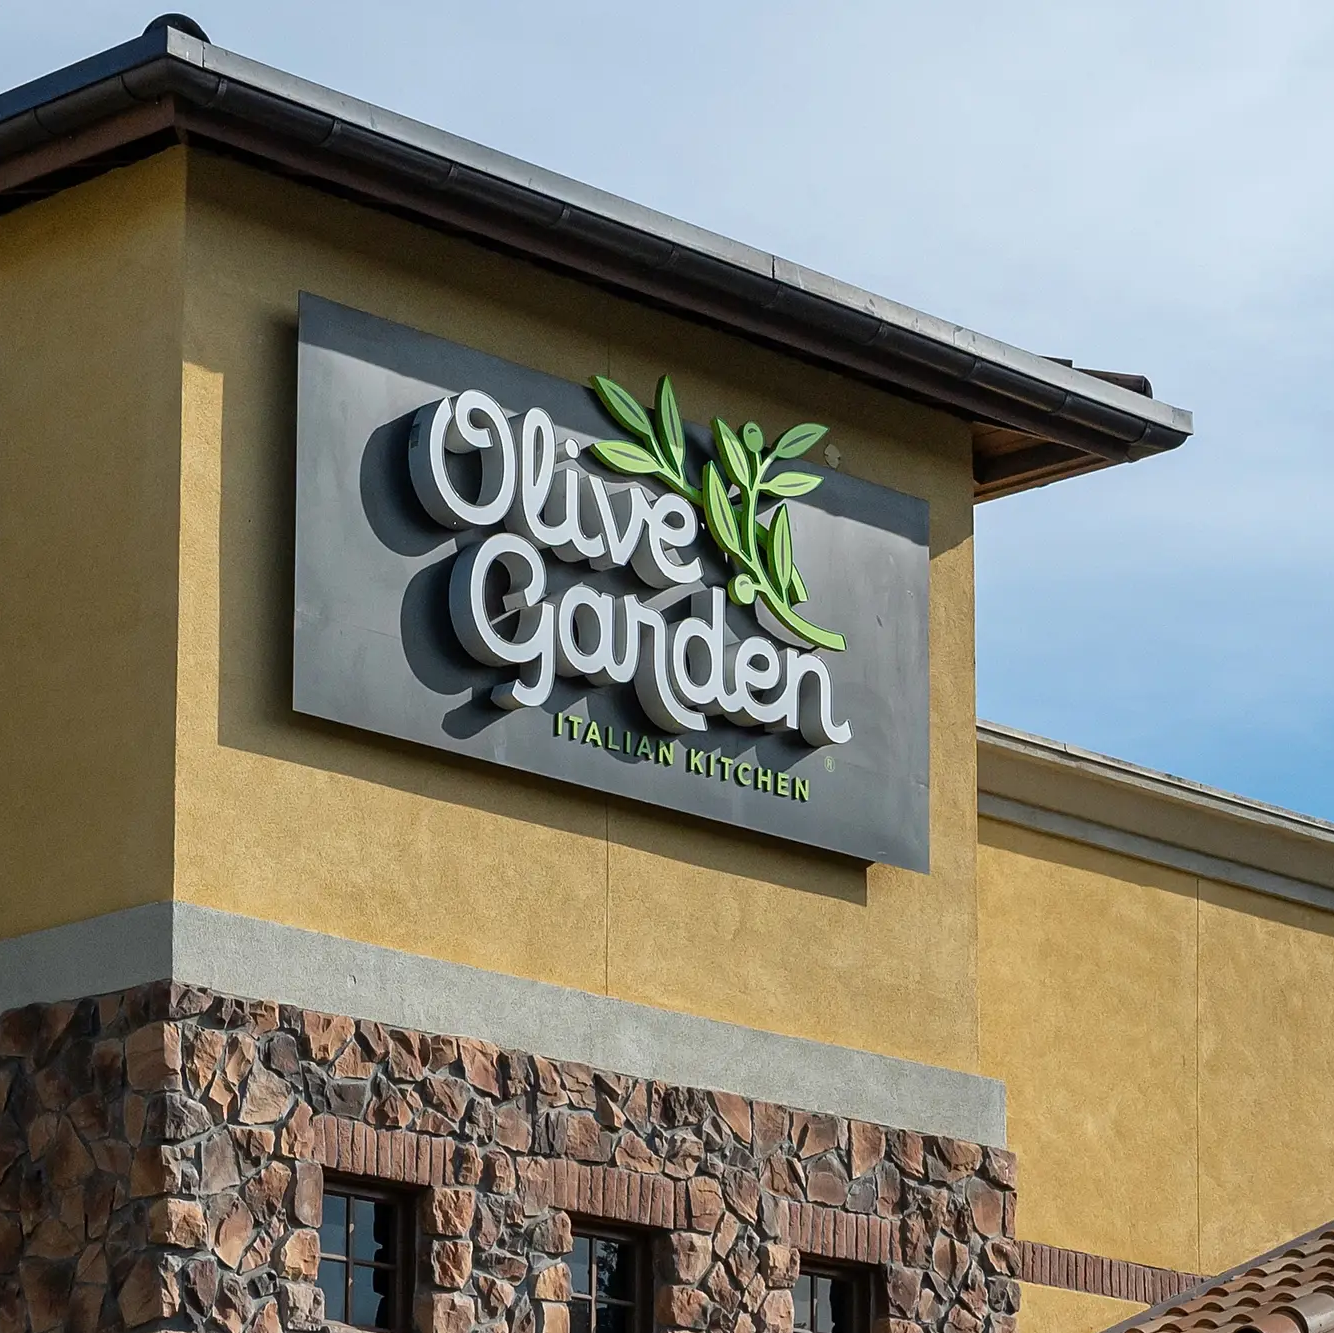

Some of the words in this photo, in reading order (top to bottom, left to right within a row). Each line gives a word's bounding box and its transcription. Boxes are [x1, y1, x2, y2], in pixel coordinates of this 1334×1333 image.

[425, 388, 704, 584] Olive
[469, 532, 855, 745] Garden
[554, 712, 675, 765] ITALIAN
[688, 748, 810, 801] KITCHEN
